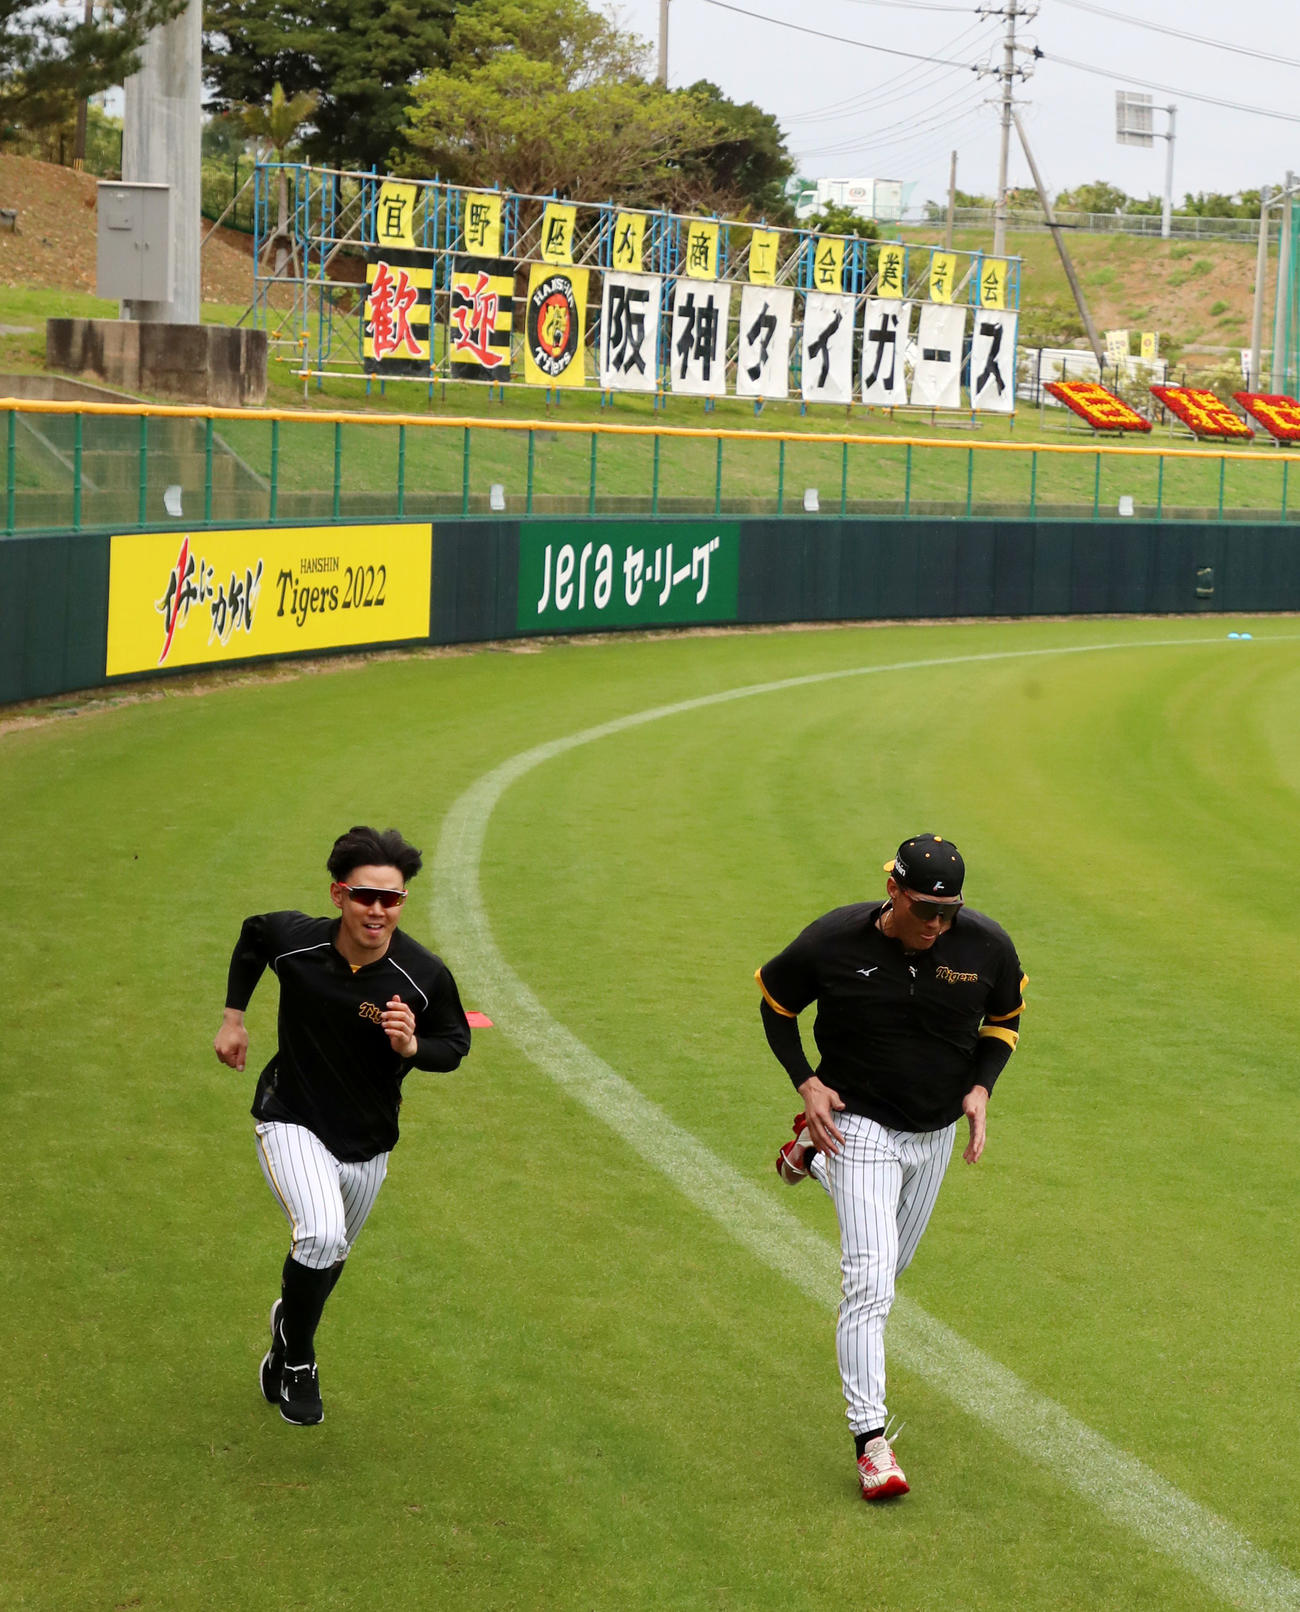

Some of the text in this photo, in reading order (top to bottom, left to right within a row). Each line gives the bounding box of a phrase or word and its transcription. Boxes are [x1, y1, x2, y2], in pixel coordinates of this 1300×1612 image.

[606, 284, 1006, 396] 阪神タイガース
[300, 556, 339, 574] HANSHIN
[276, 564, 387, 627] Tigers 2022
[936, 965, 979, 985] Tigers
